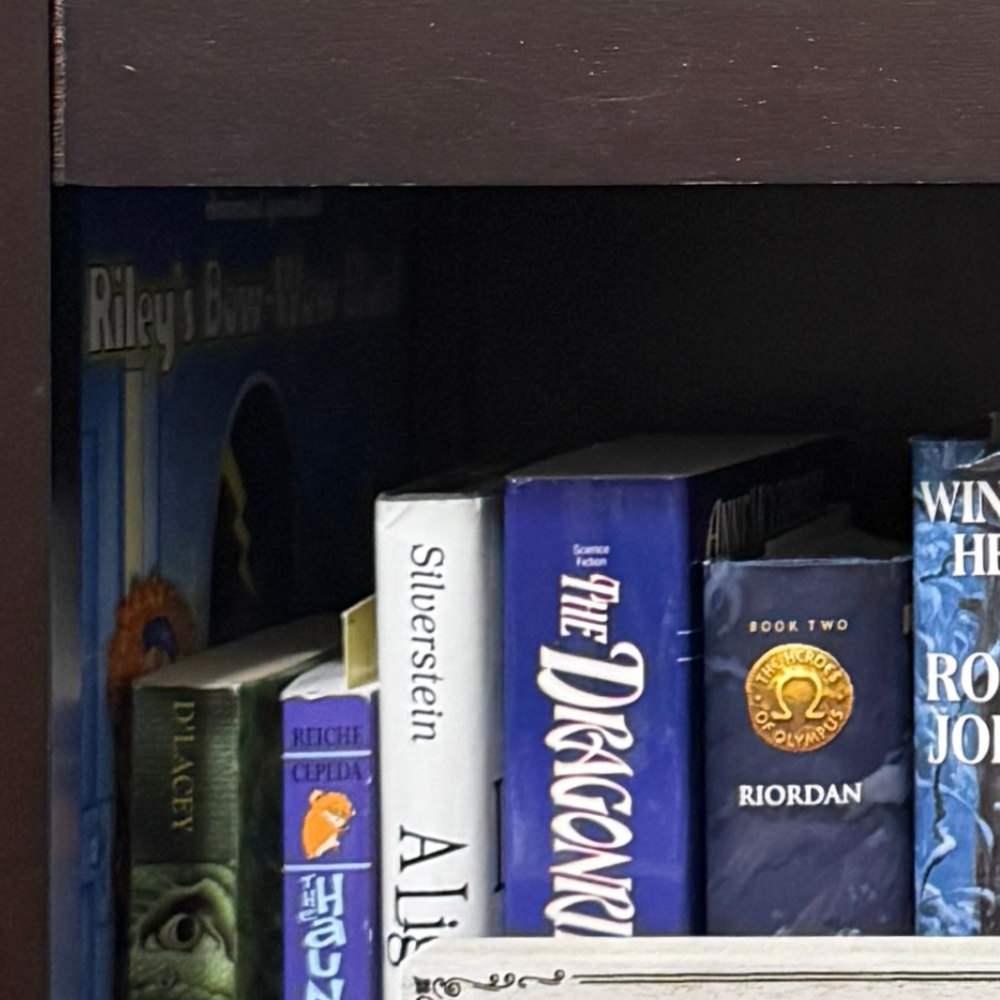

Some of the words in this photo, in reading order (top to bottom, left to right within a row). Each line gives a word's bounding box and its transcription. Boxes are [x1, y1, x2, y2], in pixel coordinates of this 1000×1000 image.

[89, 262, 194, 372] Riley's
[410, 543, 445, 742] Silverstein
[749, 620, 799, 632] BOOK
[808, 618, 848, 631] TWO
[756, 657, 782, 685] THE
[783, 648, 843, 684] HEROES
[292, 726, 362, 748] REICHE
[755, 710, 776, 731] OF
[774, 708, 844, 748] OLYMPUS
[171, 701, 195, 832] D'LACEY
[738, 782, 862, 807] RIORDAN
[400, 824, 469, 873] A
